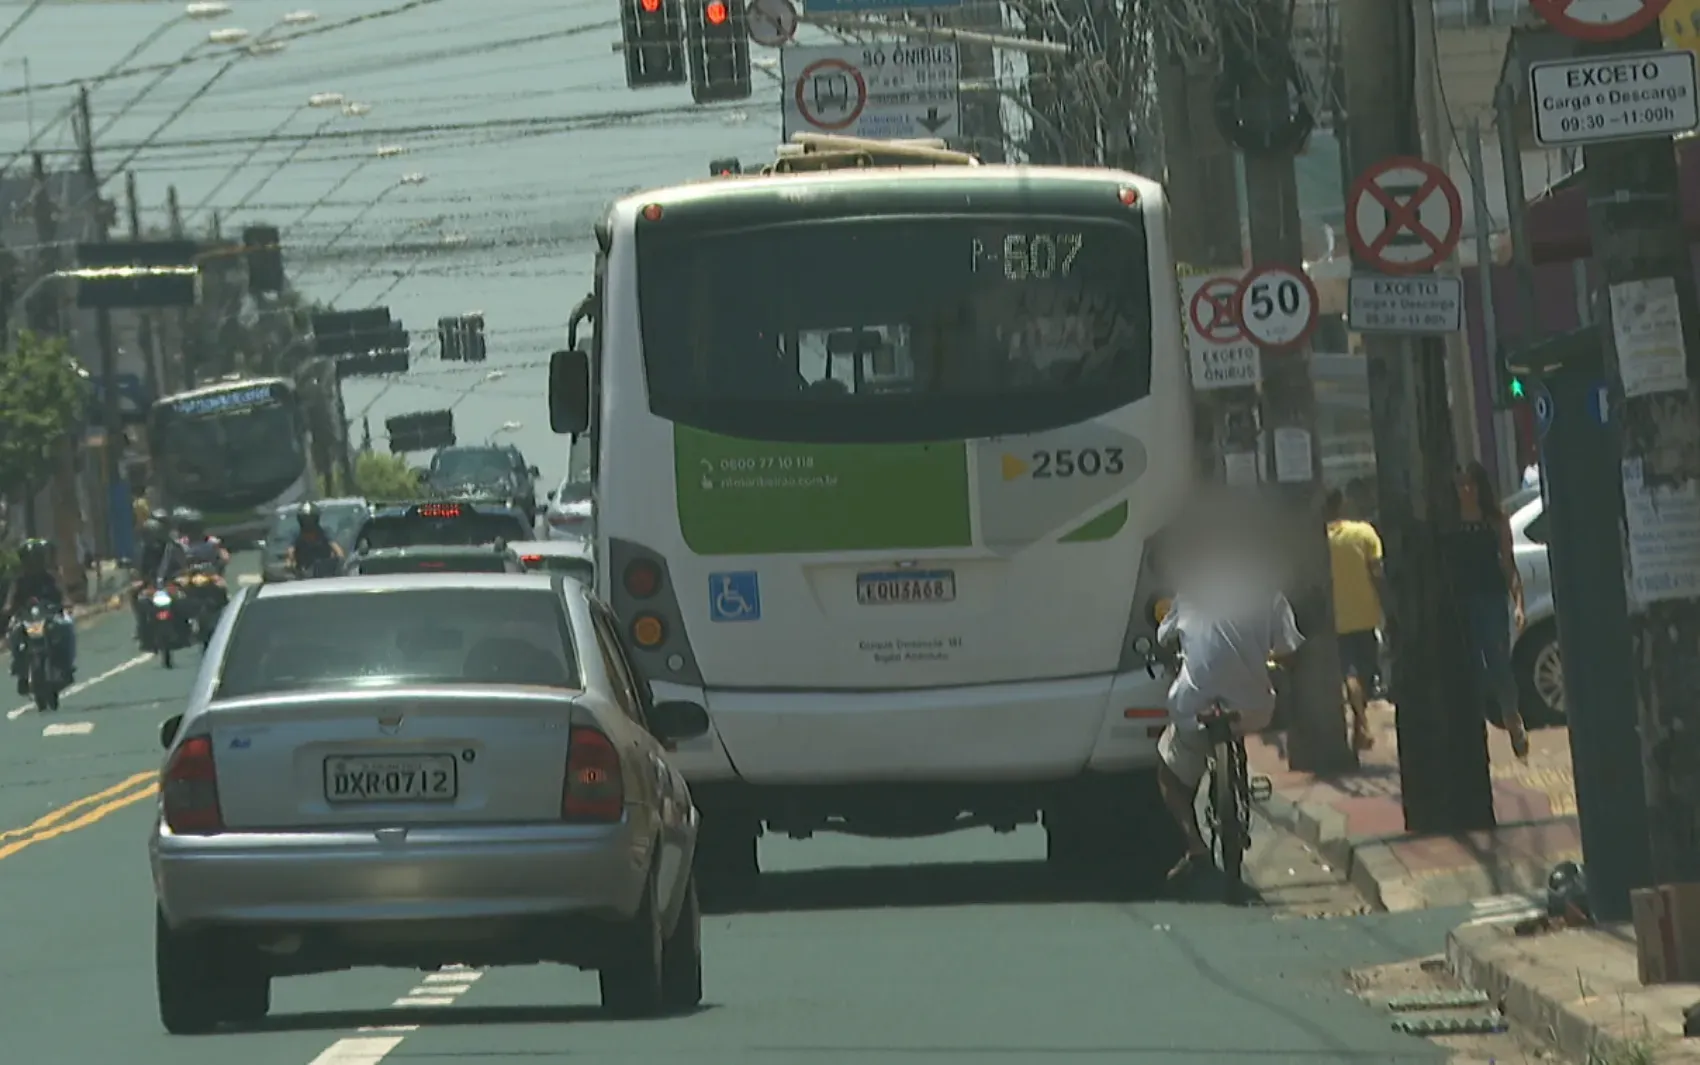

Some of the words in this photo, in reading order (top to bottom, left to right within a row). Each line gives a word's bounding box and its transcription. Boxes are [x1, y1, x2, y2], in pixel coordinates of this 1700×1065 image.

[1566, 61, 1659, 88] EXCETO
[1542, 94, 1591, 112] Carga
[1596, 93, 1606, 106] e
[1608, 85, 1687, 106] Descarga
[1560, 114, 1605, 132] 09:30
[1251, 279, 1300, 320] 50
[1373, 281, 1439, 296] EXCETO
[1202, 347, 1254, 363] EXCETO
[720, 457, 756, 471] 0800
[759, 456, 774, 469] 77
[778, 455, 793, 470] 10
[796, 455, 814, 469] 118
[1032, 447, 1124, 480] 2503
